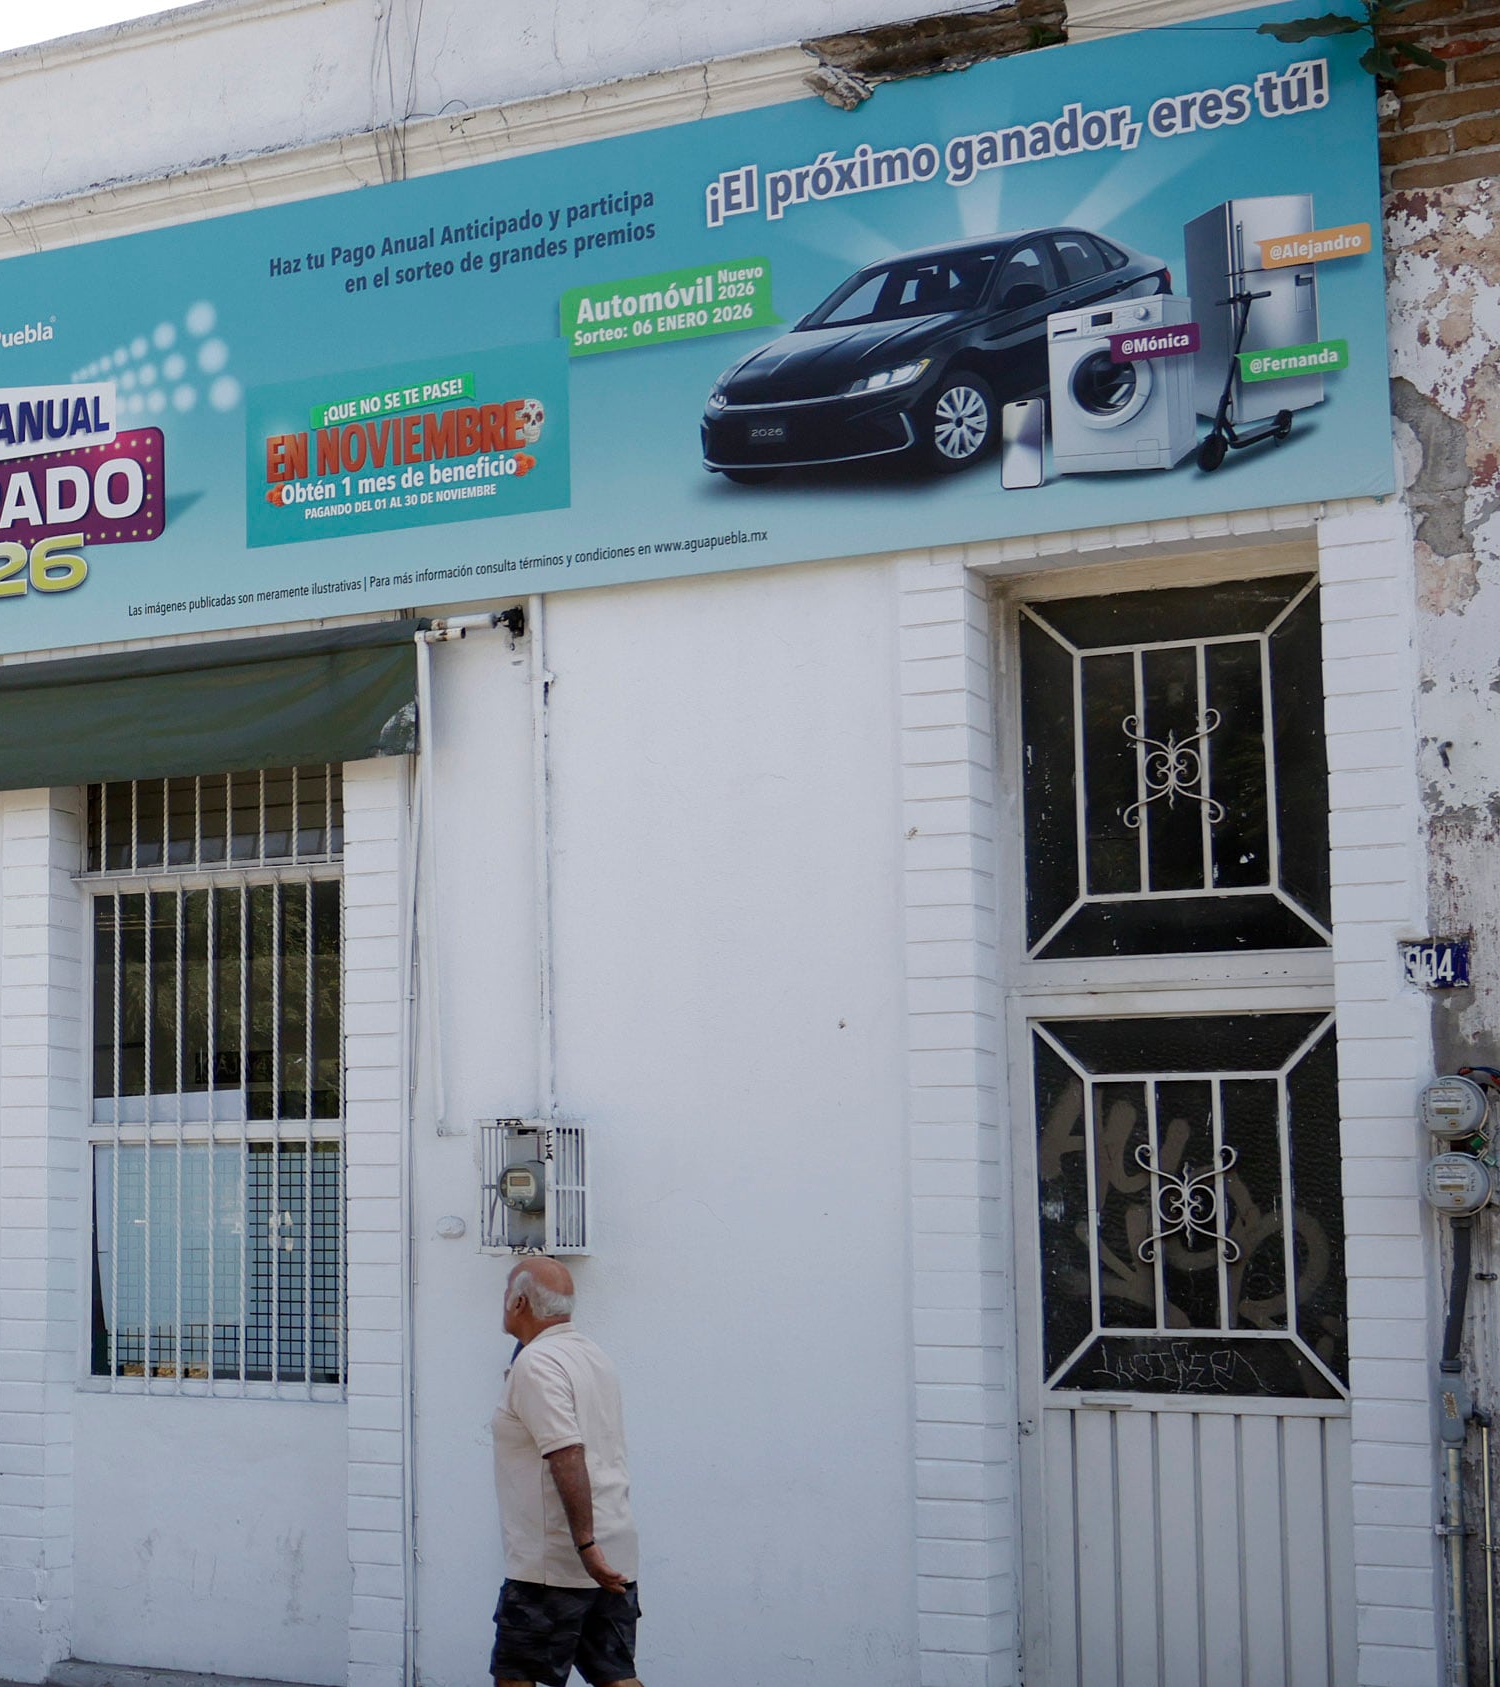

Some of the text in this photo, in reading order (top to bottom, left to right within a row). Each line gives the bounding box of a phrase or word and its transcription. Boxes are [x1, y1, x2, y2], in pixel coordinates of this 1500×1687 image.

[706, 61, 1327, 226] ¡El próximo ganador, eres tú!
[269, 191, 654, 277] Haz tu Pago Anual Anticipado y participa
[345, 222, 656, 293] en el sorteo de grandes premios
[1269, 233, 1362, 261] @Alejandro
[576, 266, 764, 324] Automóvil Nuevo
[717, 281, 755, 300] 2026
[574, 303, 753, 346] Sorteo: 06 ENERO 2026
[1121, 332, 1190, 355] @Mónica
[1250, 348, 1339, 374] @Fernanda
[323, 378, 463, 426] ¡QUE NO SE TE PASE!
[266, 399, 527, 483] EN NOVIEMBRE
[750, 427, 784, 437] 2026
[281, 455, 518, 505] Obtén 1 mes de beneficio
[304, 484, 497, 520] PAGANDO DEL 01 AL 30 DE NOVIEMBRE
[128, 529, 768, 617] Las imágenes publicadas son meramente ilustrativas Para más información consulta términos y condiciones en www.aguapuebla.mx
